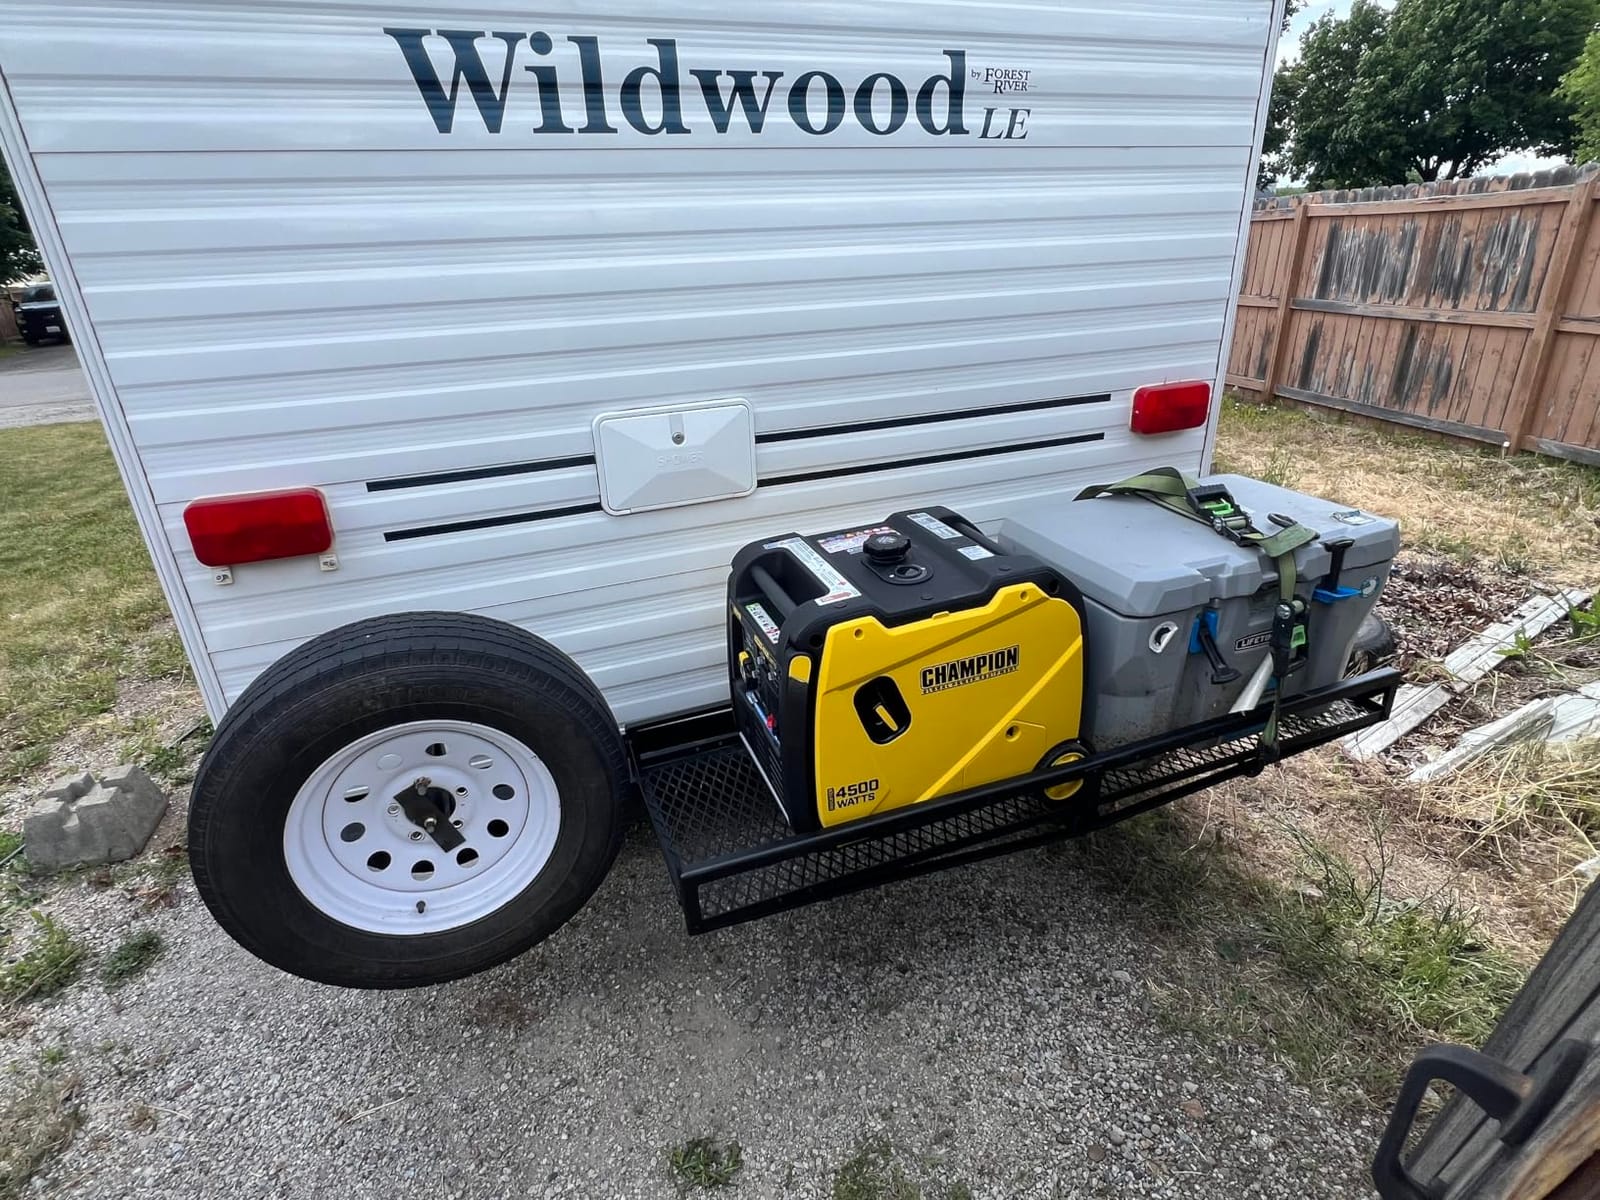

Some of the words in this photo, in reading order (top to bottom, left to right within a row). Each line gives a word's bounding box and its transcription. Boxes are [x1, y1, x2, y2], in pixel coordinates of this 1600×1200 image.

[383, 27, 970, 135] Wildwood
[971, 69, 981, 80] by
[985, 68, 1031, 82] FOREST
[993, 80, 1027, 94] RIVER
[977, 108, 1031, 140] LE
[921, 646, 1019, 689] CHAMPION
[836, 779, 879, 798] 4500
[837, 792, 875, 808] WATTS
